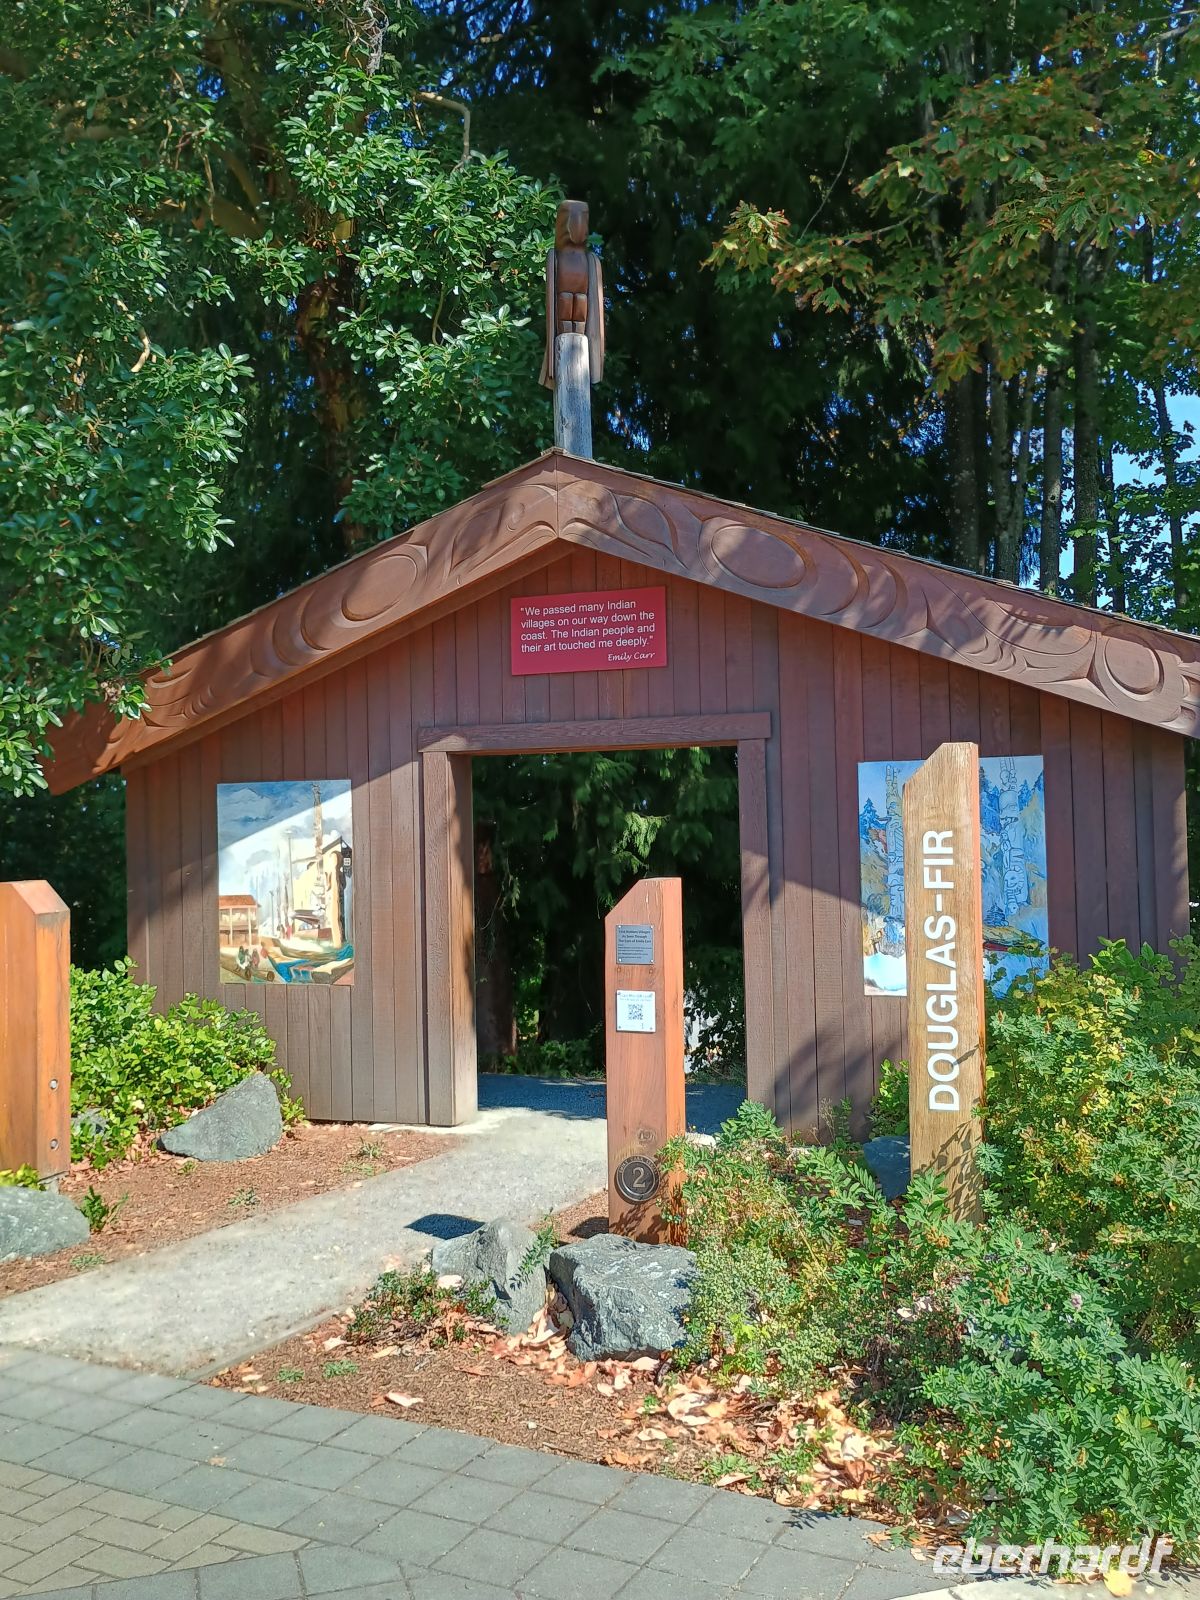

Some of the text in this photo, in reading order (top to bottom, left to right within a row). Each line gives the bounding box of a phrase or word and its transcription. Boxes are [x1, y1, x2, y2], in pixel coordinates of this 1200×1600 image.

[520, 600, 636, 617] "We passed many Indian
[520, 610, 655, 630] villages on our way down the
[520, 623, 655, 641] coast. The Indian people and
[521, 635, 654, 653] their art touched me deeply."
[607, 651, 655, 663] Emily Carr
[922, 830, 960, 1112] DOUGLAS-FIR
[632, 1167, 646, 1188] 2
